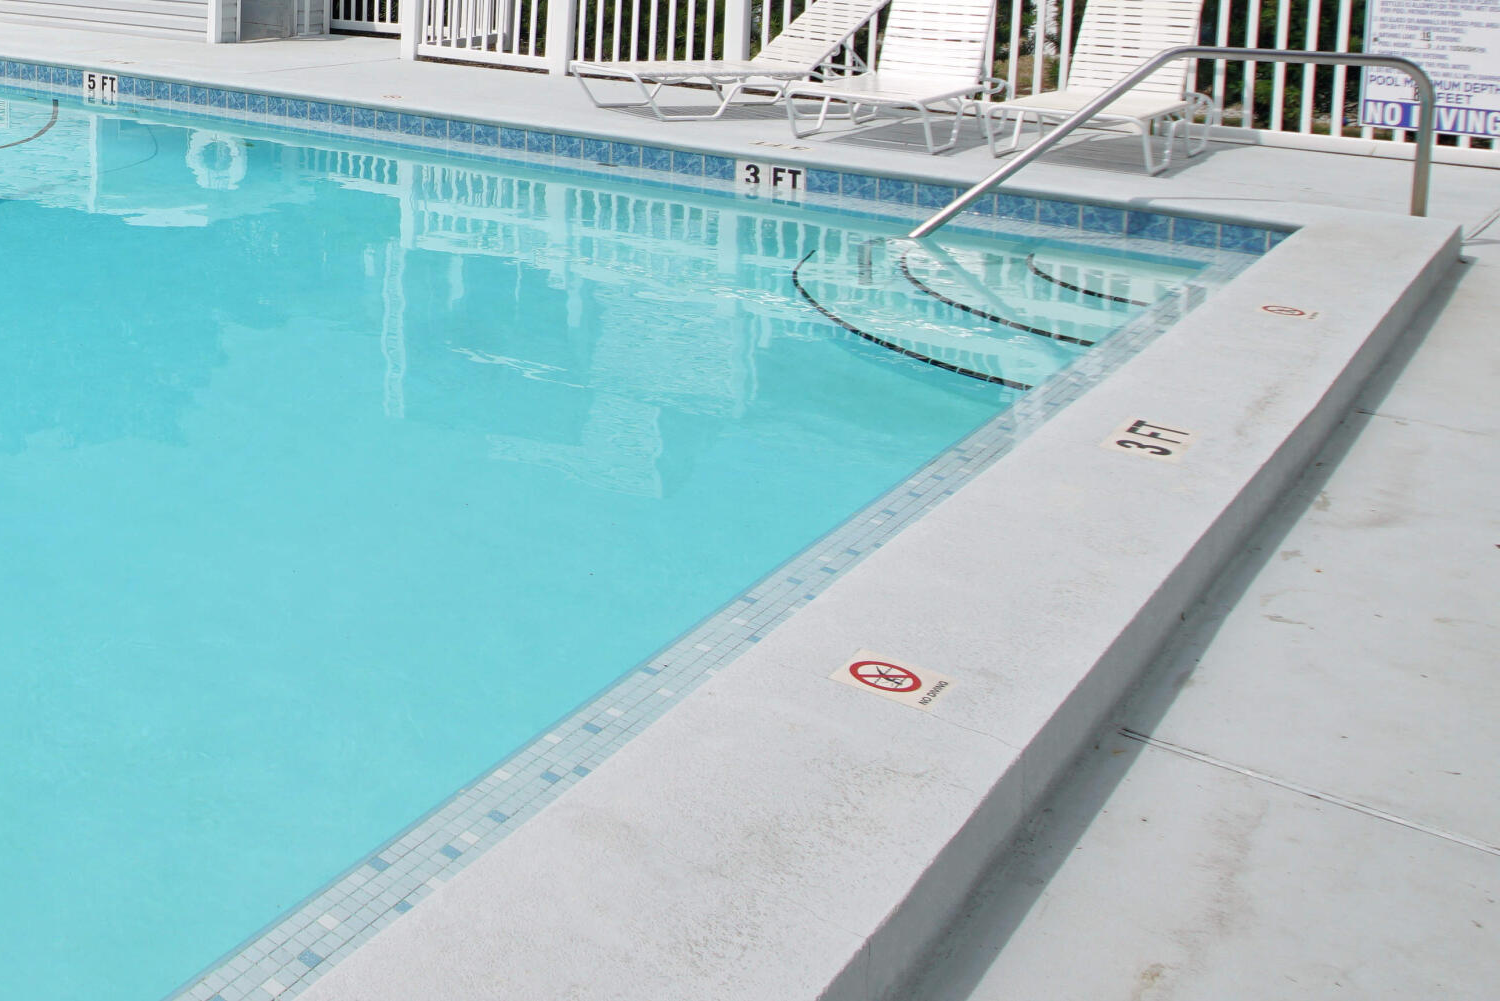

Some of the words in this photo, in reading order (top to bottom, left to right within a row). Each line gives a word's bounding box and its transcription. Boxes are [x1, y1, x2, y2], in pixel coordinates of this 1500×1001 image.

[88, 74, 96, 90] 5
[1369, 74, 1402, 87] POOL
[1436, 92, 1474, 104] FEET
[1365, 100, 1403, 126] NO
[745, 164, 760, 184] 3
[1126, 419, 1190, 444] FT
[1116, 439, 1173, 456] 3
[918, 696, 932, 706] NO
[927, 680, 949, 698] DIVING
